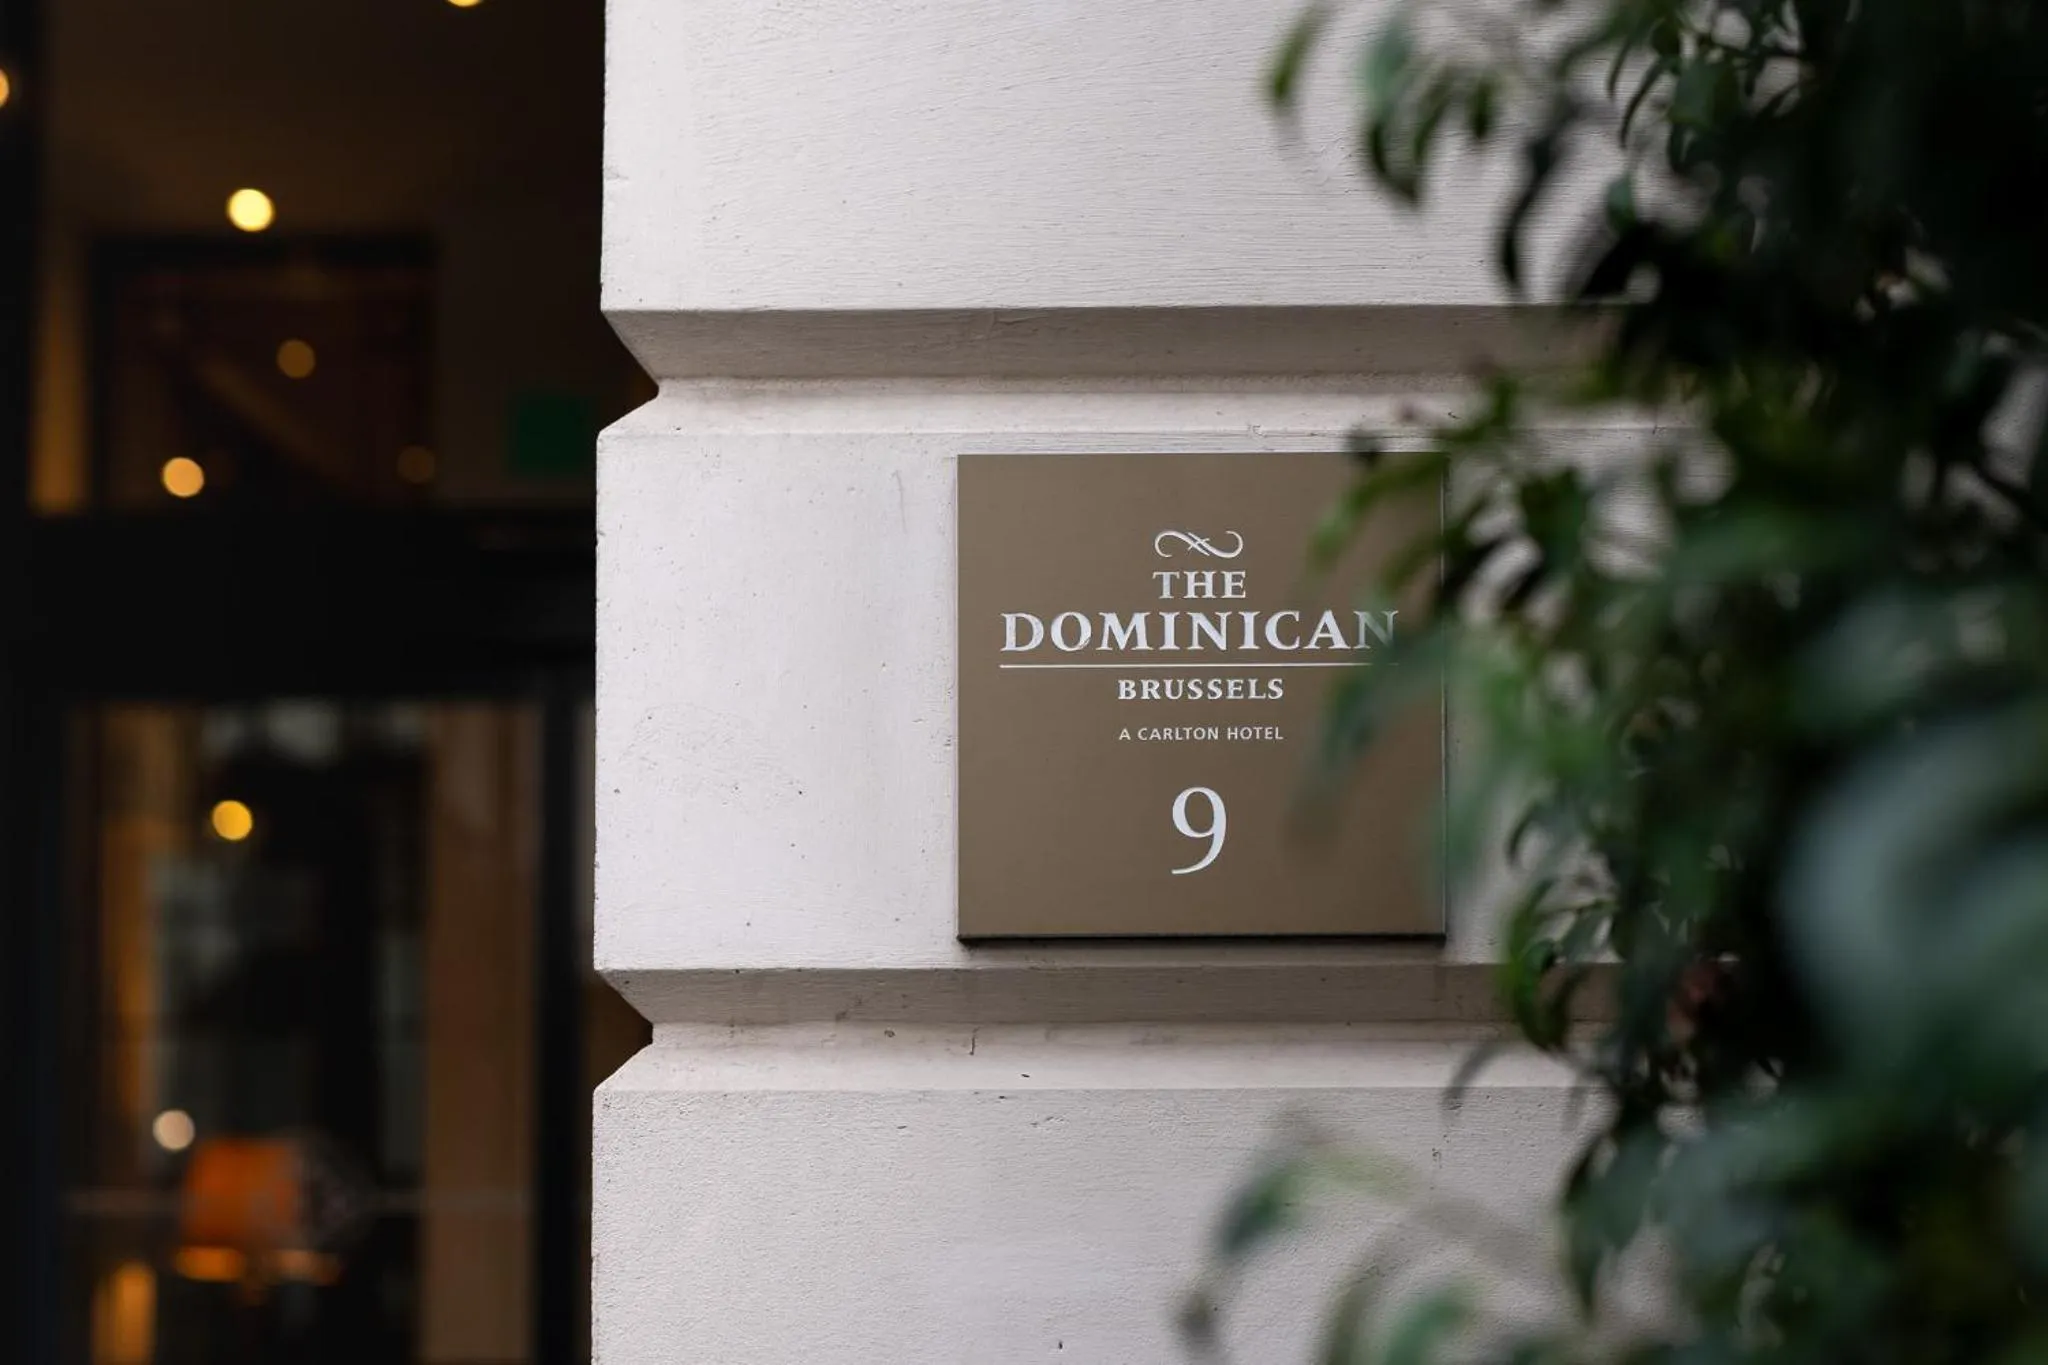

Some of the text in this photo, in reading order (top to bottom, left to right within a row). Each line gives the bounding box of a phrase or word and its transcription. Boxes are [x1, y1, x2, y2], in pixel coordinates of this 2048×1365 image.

[1152, 570, 1247, 599] THE
[999, 609, 1399, 652] DOMINICAN
[1117, 678, 1284, 700] BRUSSELS
[1118, 726, 1284, 741] A CARLTON HOTEL
[1171, 786, 1227, 875] 9
